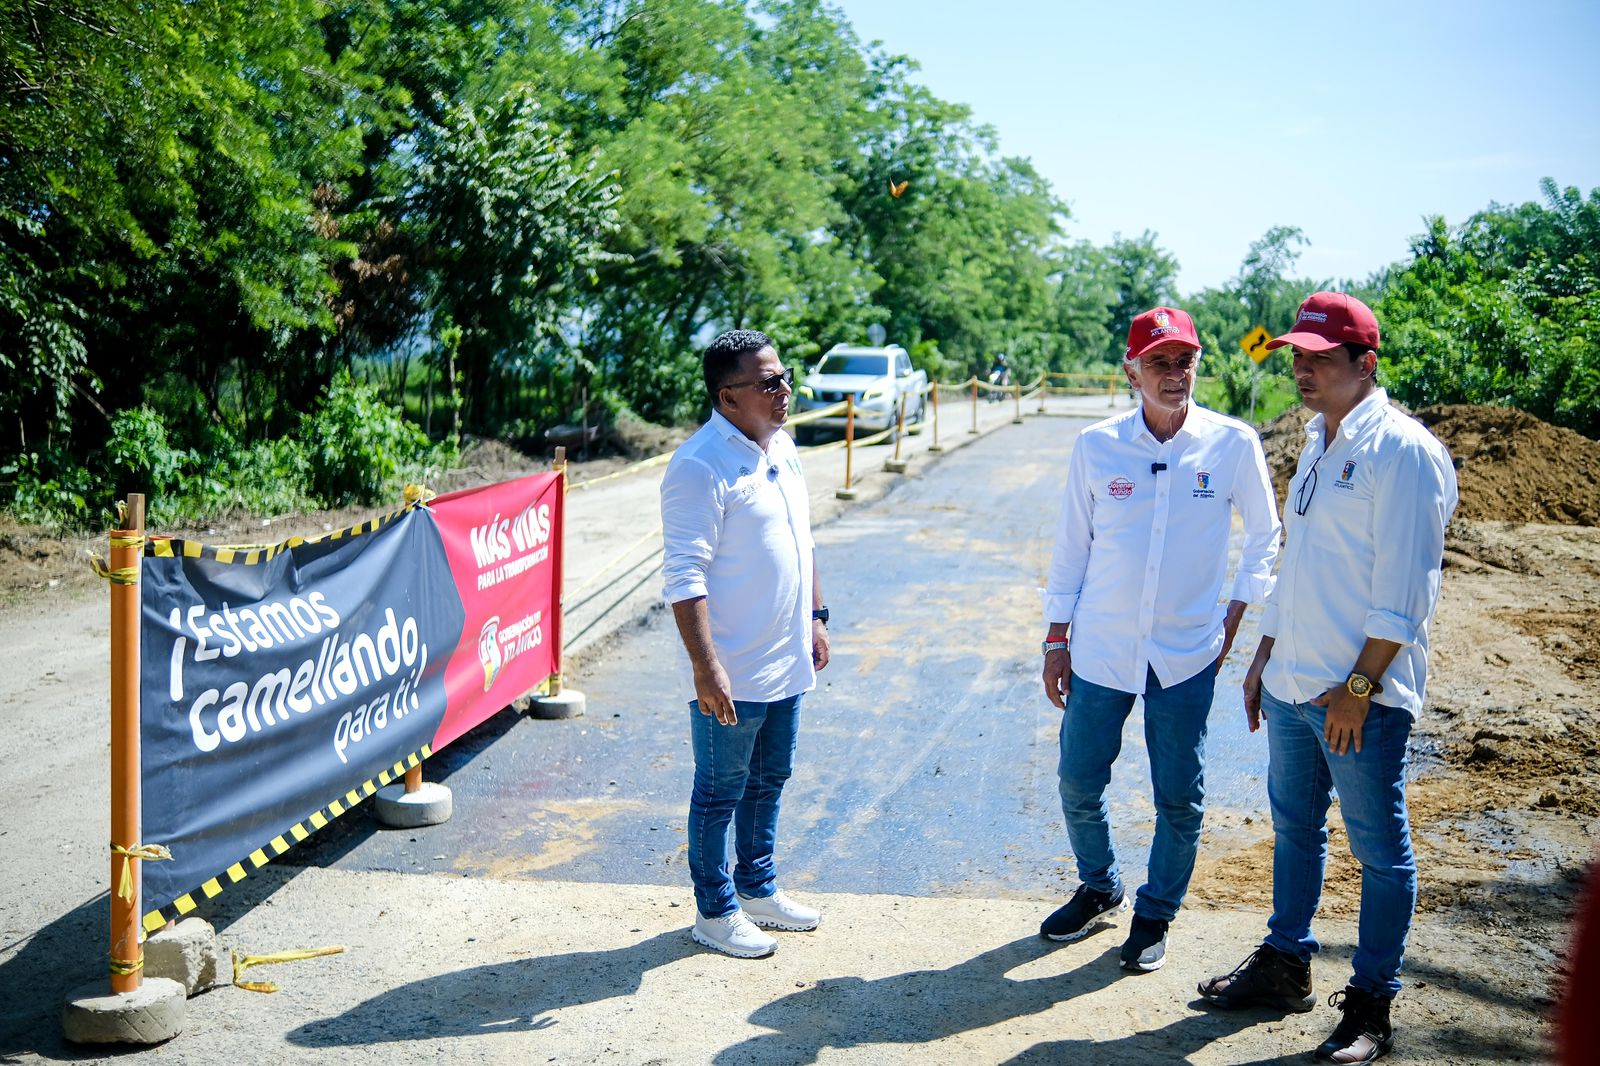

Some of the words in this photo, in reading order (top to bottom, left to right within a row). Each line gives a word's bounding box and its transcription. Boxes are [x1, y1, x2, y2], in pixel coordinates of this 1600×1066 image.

[470, 512, 512, 569] MÁS
[477, 568, 497, 592] PARA
[495, 564, 505, 585] LA
[333, 692, 391, 764] para
